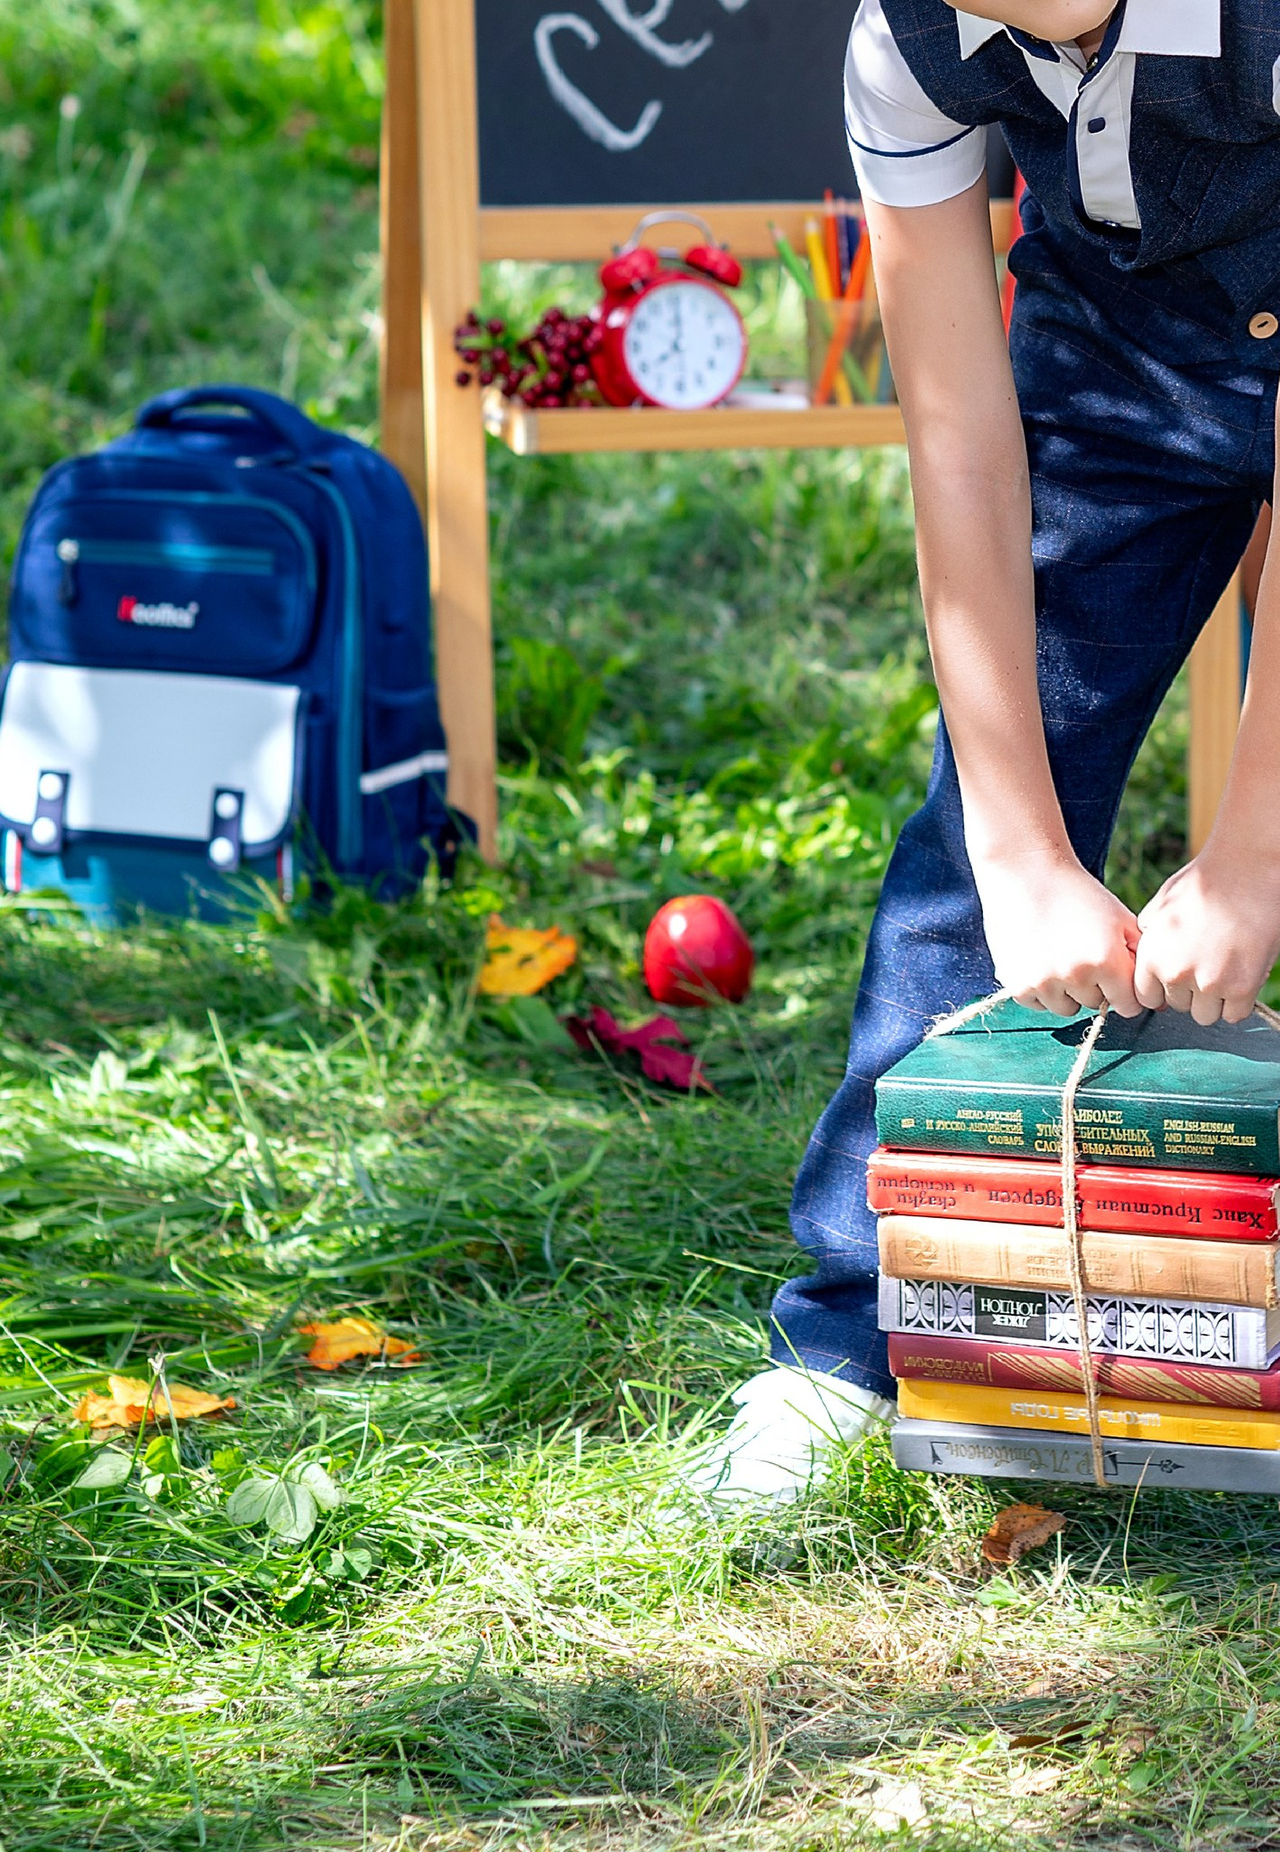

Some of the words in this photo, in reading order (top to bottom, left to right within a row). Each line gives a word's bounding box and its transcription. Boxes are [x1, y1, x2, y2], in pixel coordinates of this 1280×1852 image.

[1060, 1108, 1123, 1124] АИБОЛЕЕ
[1035, 1123, 1151, 1143] УПОЕБИТЕЛЬНЫХ
[1163, 1119, 1235, 1133] ENGLISH-RUSSIAN
[987, 1134, 1025, 1146] СЛОВАРЬ
[1163, 1132, 1182, 1142] AND
[1184, 1133, 1257, 1146] RUSSIAN-ENGLISH
[1082, 1142, 1156, 1158] ВЫРАЖЕНИЙ
[1164, 1144, 1215, 1155] DICTIONARY
[896, 1191, 957, 1210] сказки
[1096, 1199, 1203, 1224] Кристиан
[1212, 1208, 1265, 1229] Ханс
[980, 1297, 1043, 1317] ЛОНДОН
[991, 1314, 1031, 1328] ДЖЕК
[1010, 1402, 1060, 1420] ГОДЫ
[1063, 1406, 1161, 1427] ШКОЛЬЫЕ
